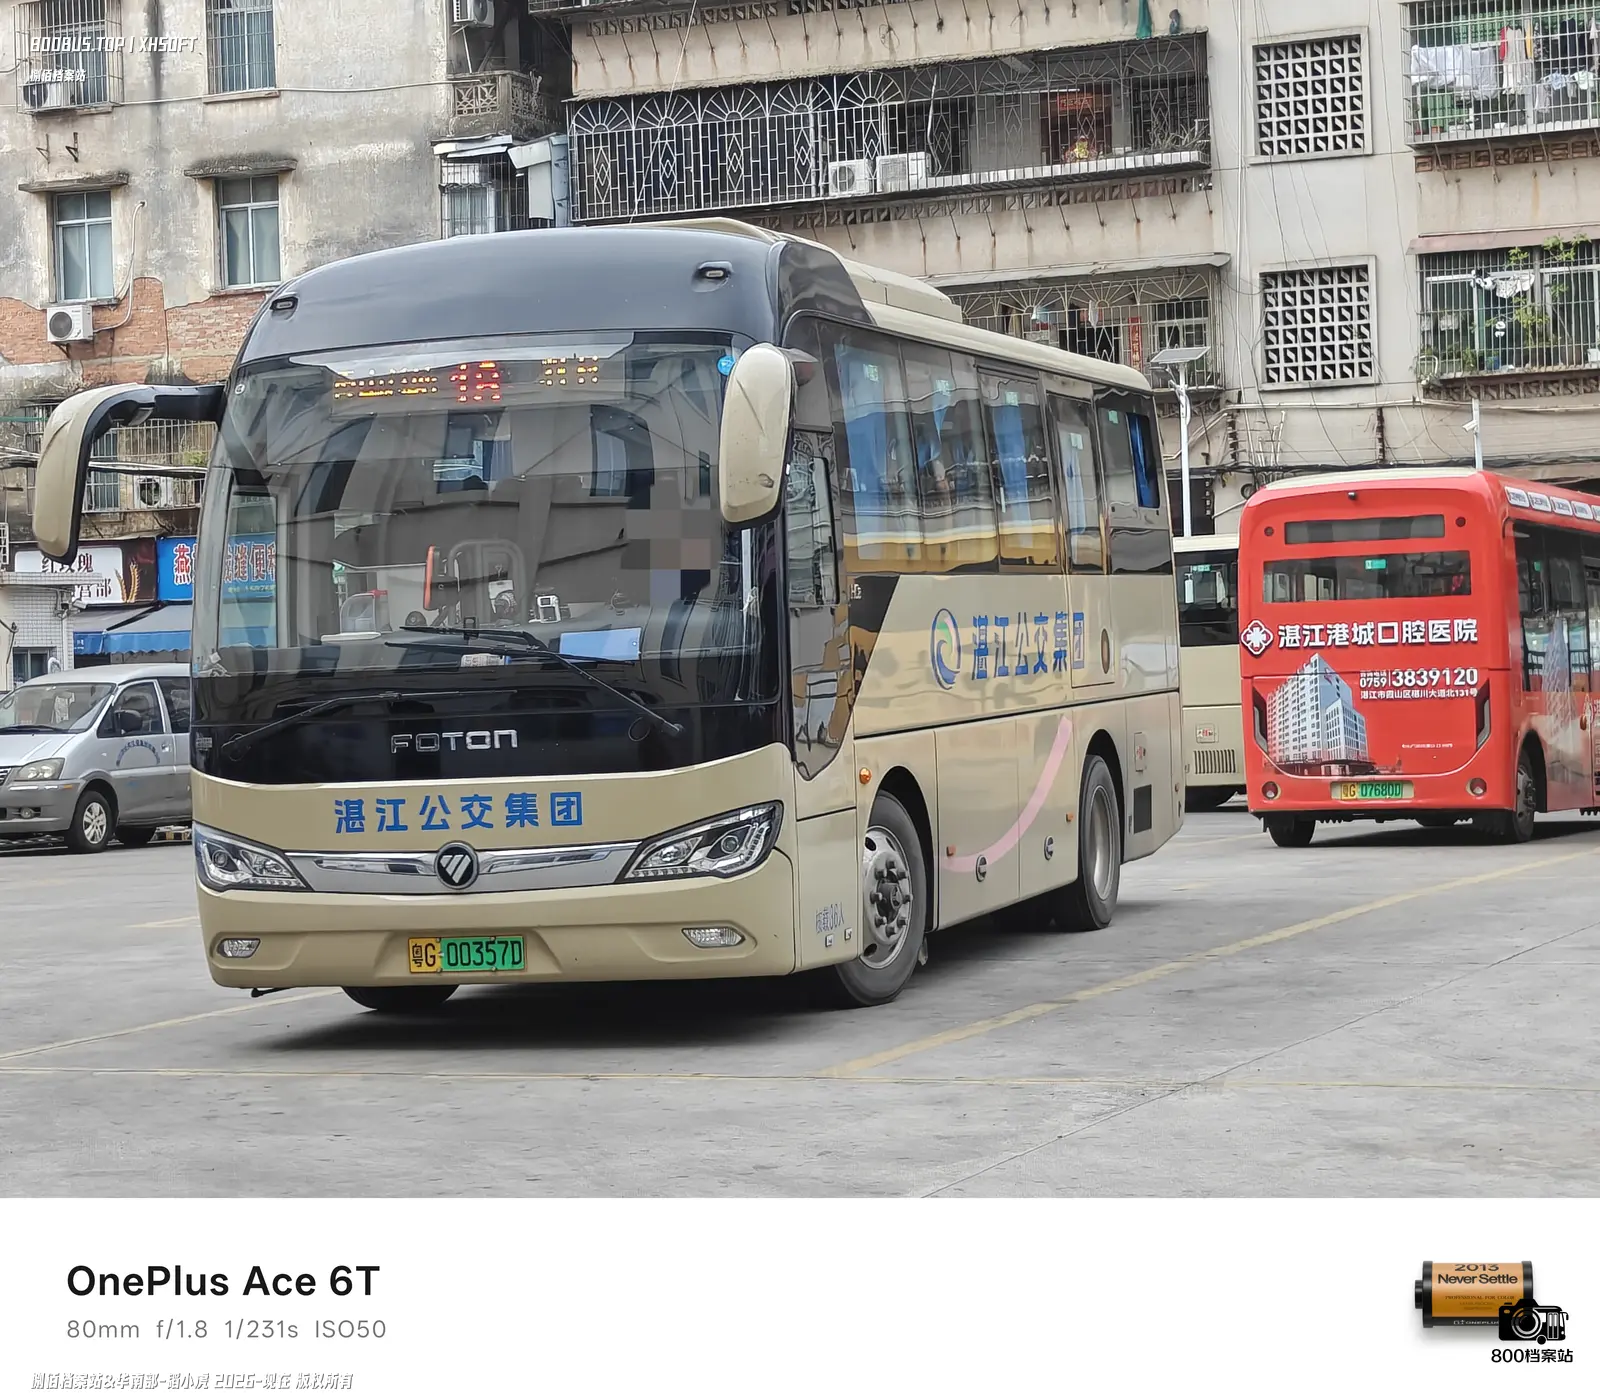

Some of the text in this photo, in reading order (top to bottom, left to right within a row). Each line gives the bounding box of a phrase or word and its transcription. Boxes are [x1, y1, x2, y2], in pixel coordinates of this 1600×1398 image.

[972, 610, 1085, 681] 湛江公交集团
[1277, 618, 1479, 648] 湛江港城口腔医院
[1359, 667, 1478, 688] 0759 3839120
[390, 729, 519, 754] FOTON
[334, 791, 583, 834] 湛江公交集团
